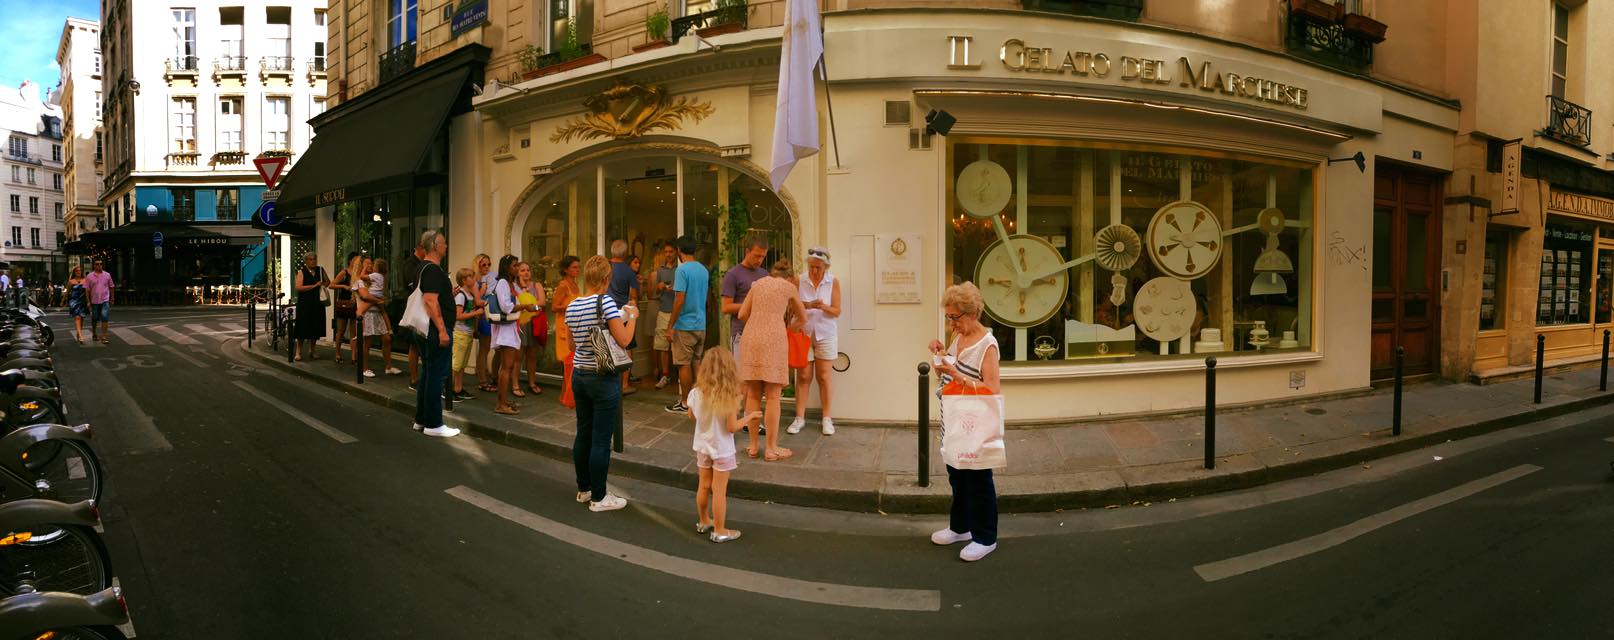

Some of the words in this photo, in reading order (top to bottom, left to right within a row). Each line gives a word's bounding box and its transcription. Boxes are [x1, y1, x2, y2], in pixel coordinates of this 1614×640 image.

[946, 35, 983, 71] IL
[1000, 38, 1111, 78] GELATO
[1120, 55, 1172, 85] DEL
[1176, 56, 1308, 110] MARCHESE
[1506, 155, 1515, 200] AGENDA
